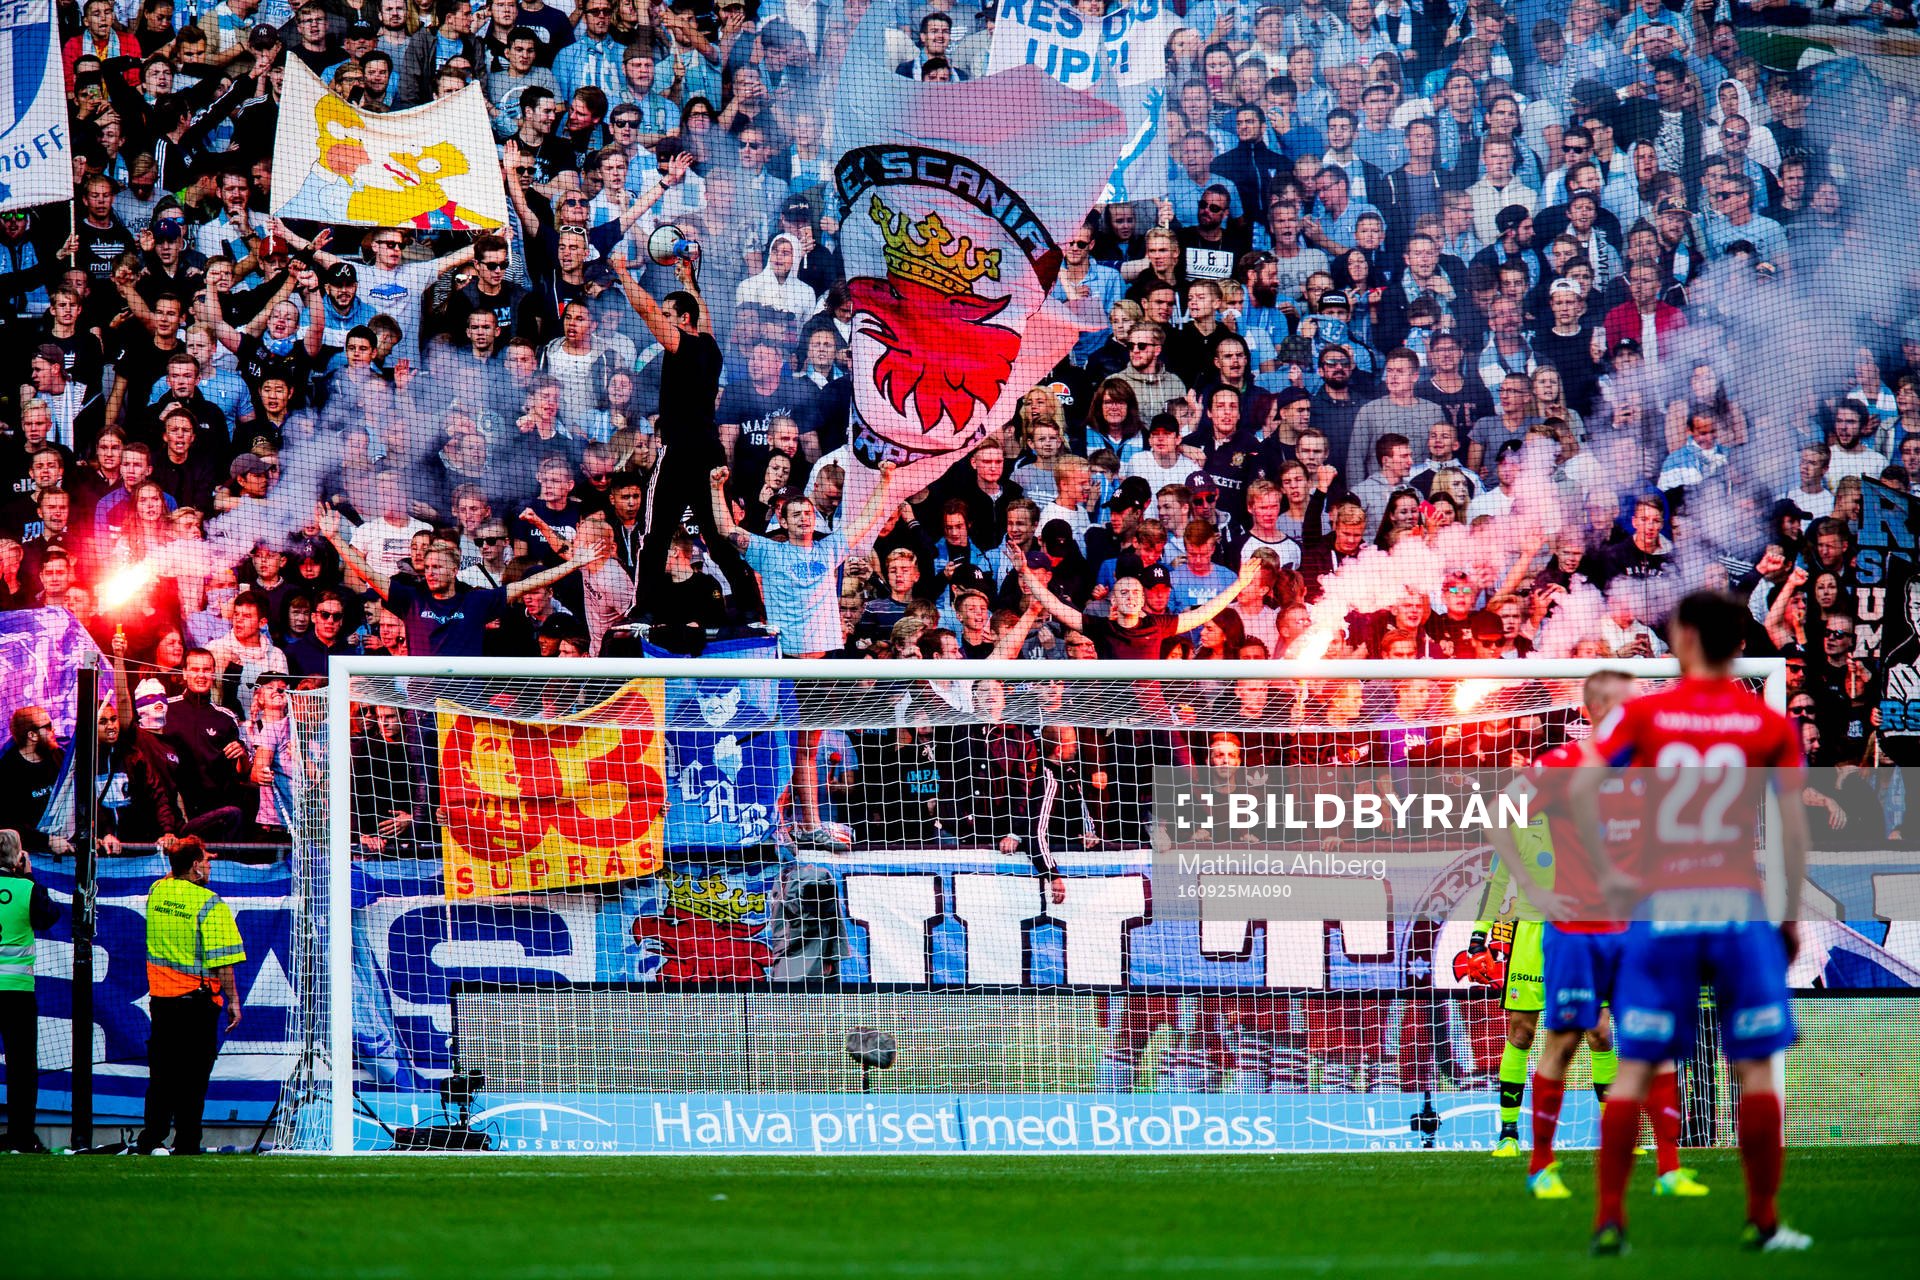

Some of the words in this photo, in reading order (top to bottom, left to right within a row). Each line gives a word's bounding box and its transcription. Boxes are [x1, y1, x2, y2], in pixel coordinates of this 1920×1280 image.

[1655, 741, 1747, 844] 22
[456, 842, 657, 895] SUPRAS
[499, 1138, 613, 1150] NDSBRON
[653, 1101, 793, 1144] Halva
[811, 1102, 955, 1152] priset
[967, 1105, 1077, 1147] med
[1091, 1103, 1276, 1147] BroPass
